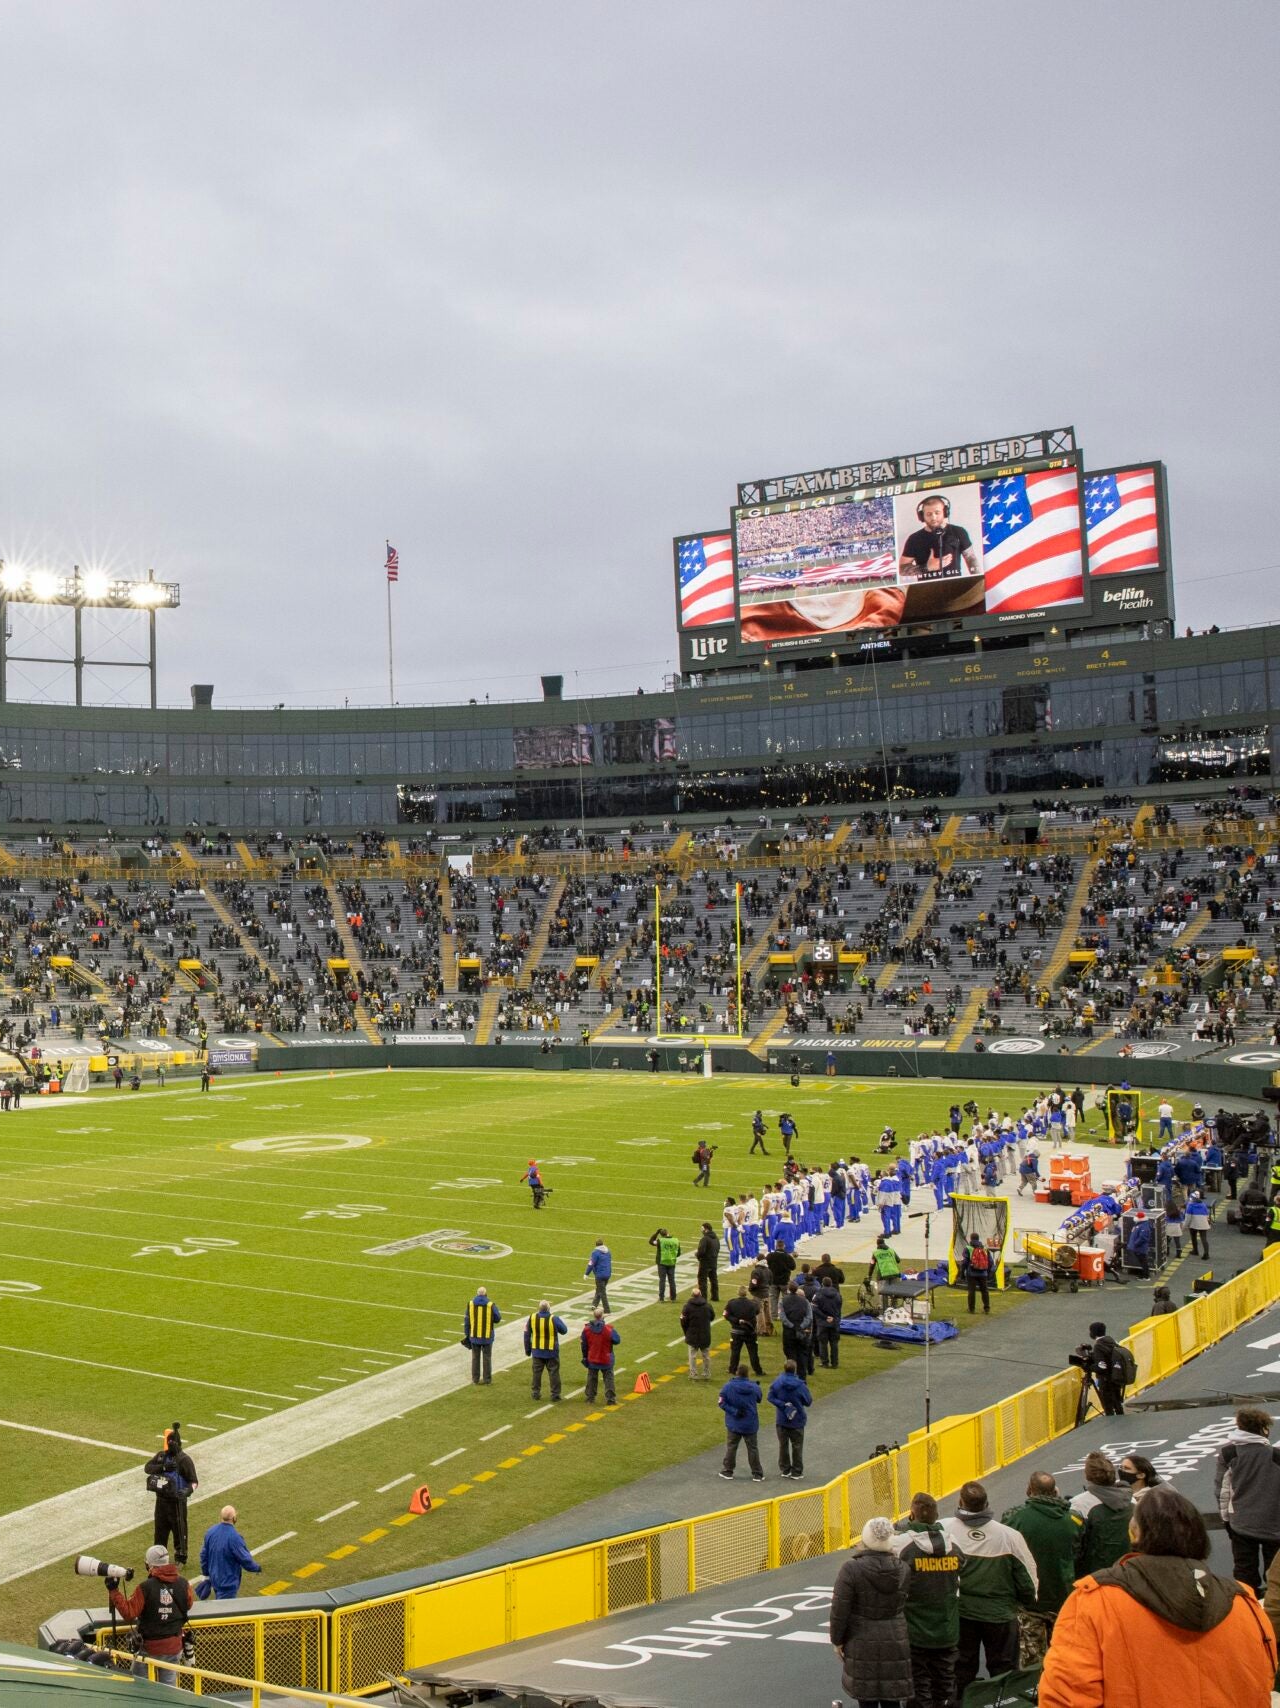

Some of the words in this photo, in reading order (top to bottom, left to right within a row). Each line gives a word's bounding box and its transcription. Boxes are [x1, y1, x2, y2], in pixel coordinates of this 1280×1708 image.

[775, 458, 918, 499] LAMBEAU
[930, 439, 1027, 474] FIELD
[1062, 458, 1069, 467] 1
[874, 485, 901, 498] 5:08
[1103, 587, 1145, 603] bellin
[1119, 597, 1154, 610] health
[999, 613, 1026, 622] DIAMOND
[1027, 611, 1046, 619] VISION
[799, 637, 822, 647] ELECTRIC
[690, 637, 729, 661] Lite
[1101, 650, 1109, 660] 4
[1033, 657, 1049, 667] 92
[903, 671, 917, 680] 15
[964, 664, 981, 674] 66
[783, 683, 795, 693] 14
[845, 677, 853, 686] 3
[815, 946, 831, 960] 25
[793, 1039, 861, 1047] PACKERS
[862, 1039, 916, 1048] UNITED
[212, 1053, 248, 1064] DIVISIONAL
[438, 1177, 503, 1190] 40
[310, 1203, 388, 1219] 30
[142, 1237, 240, 1257] 20
[1092, 1257, 1103, 1272] G
[640, 1373, 651, 1392] 10
[419, 1487, 432, 1511] G
[914, 1556, 959, 1572] PACKERS
[553, 1586, 834, 1671] ealth
